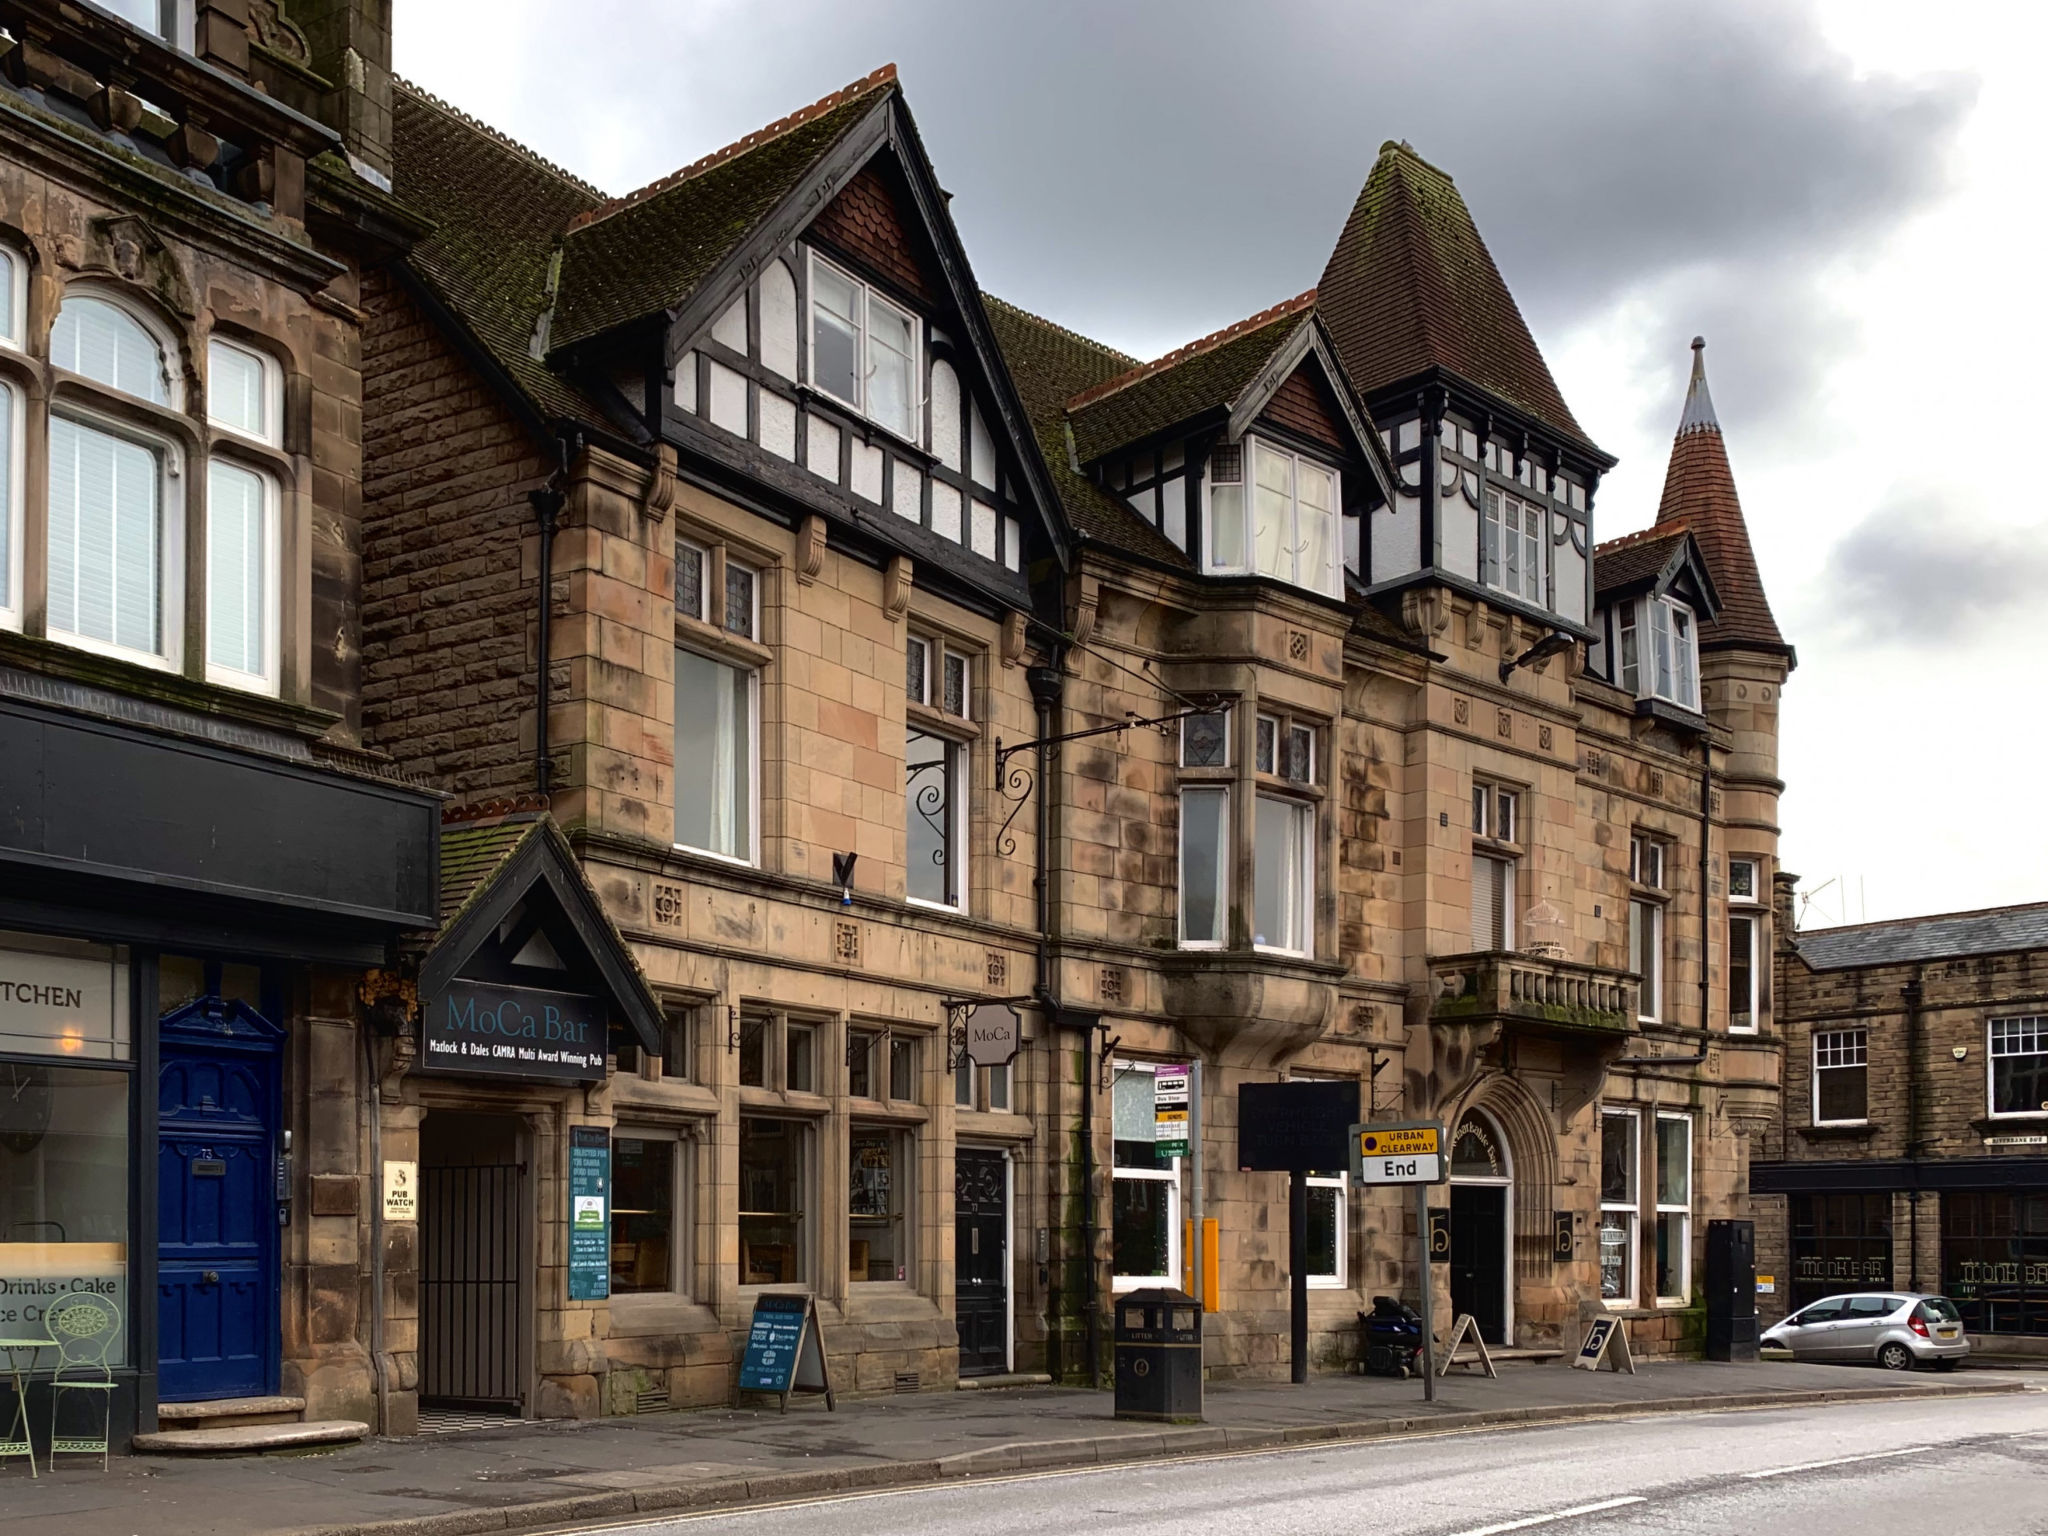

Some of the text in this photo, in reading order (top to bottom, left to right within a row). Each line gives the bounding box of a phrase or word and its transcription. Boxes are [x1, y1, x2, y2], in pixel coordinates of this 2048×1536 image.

[446, 994, 589, 1043] MoCa Bar
[974, 1026, 1010, 1042] MoCa
[430, 1039, 603, 1068] Matlock & Dales CAMRA Multi Award Winning Pub
[1389, 1132, 1424, 1141] URBAN
[1380, 1142, 1434, 1153] CLEARWAY
[1384, 1160, 1416, 1176] End
[392, 1190, 408, 1198] PUB
[386, 1199, 414, 1207] WATCH
[71, 1278, 117, 1294] Cake
